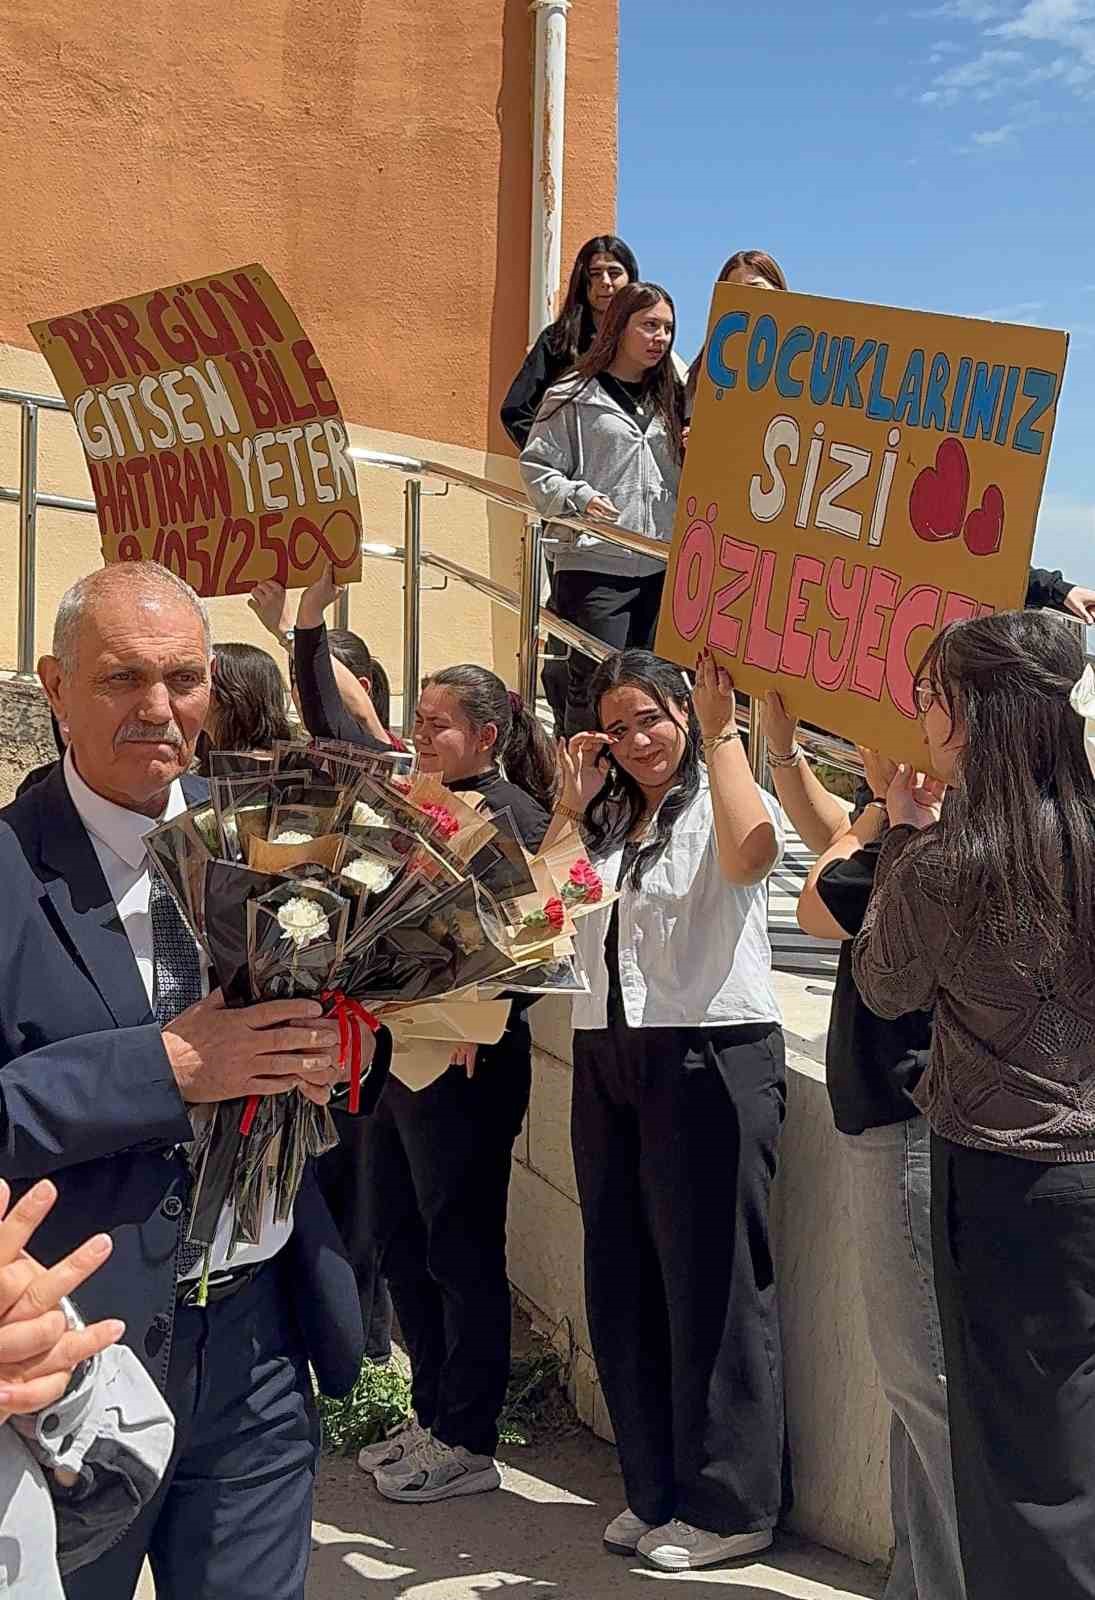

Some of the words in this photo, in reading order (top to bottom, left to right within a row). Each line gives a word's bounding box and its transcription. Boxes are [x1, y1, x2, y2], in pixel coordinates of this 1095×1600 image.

[48, 303, 160, 386] BİR
[147, 273, 285, 364] GÜN
[706, 311, 1057, 455] ÇOCUKLARINIZ
[74, 359, 241, 460] GİTSEN
[225, 340, 340, 429] BİLE
[90, 444, 232, 535] HATIRAN
[227, 419, 358, 513] YETER
[749, 413, 900, 547] SİZİ
[672, 496, 996, 720] ÖZLEYEC
